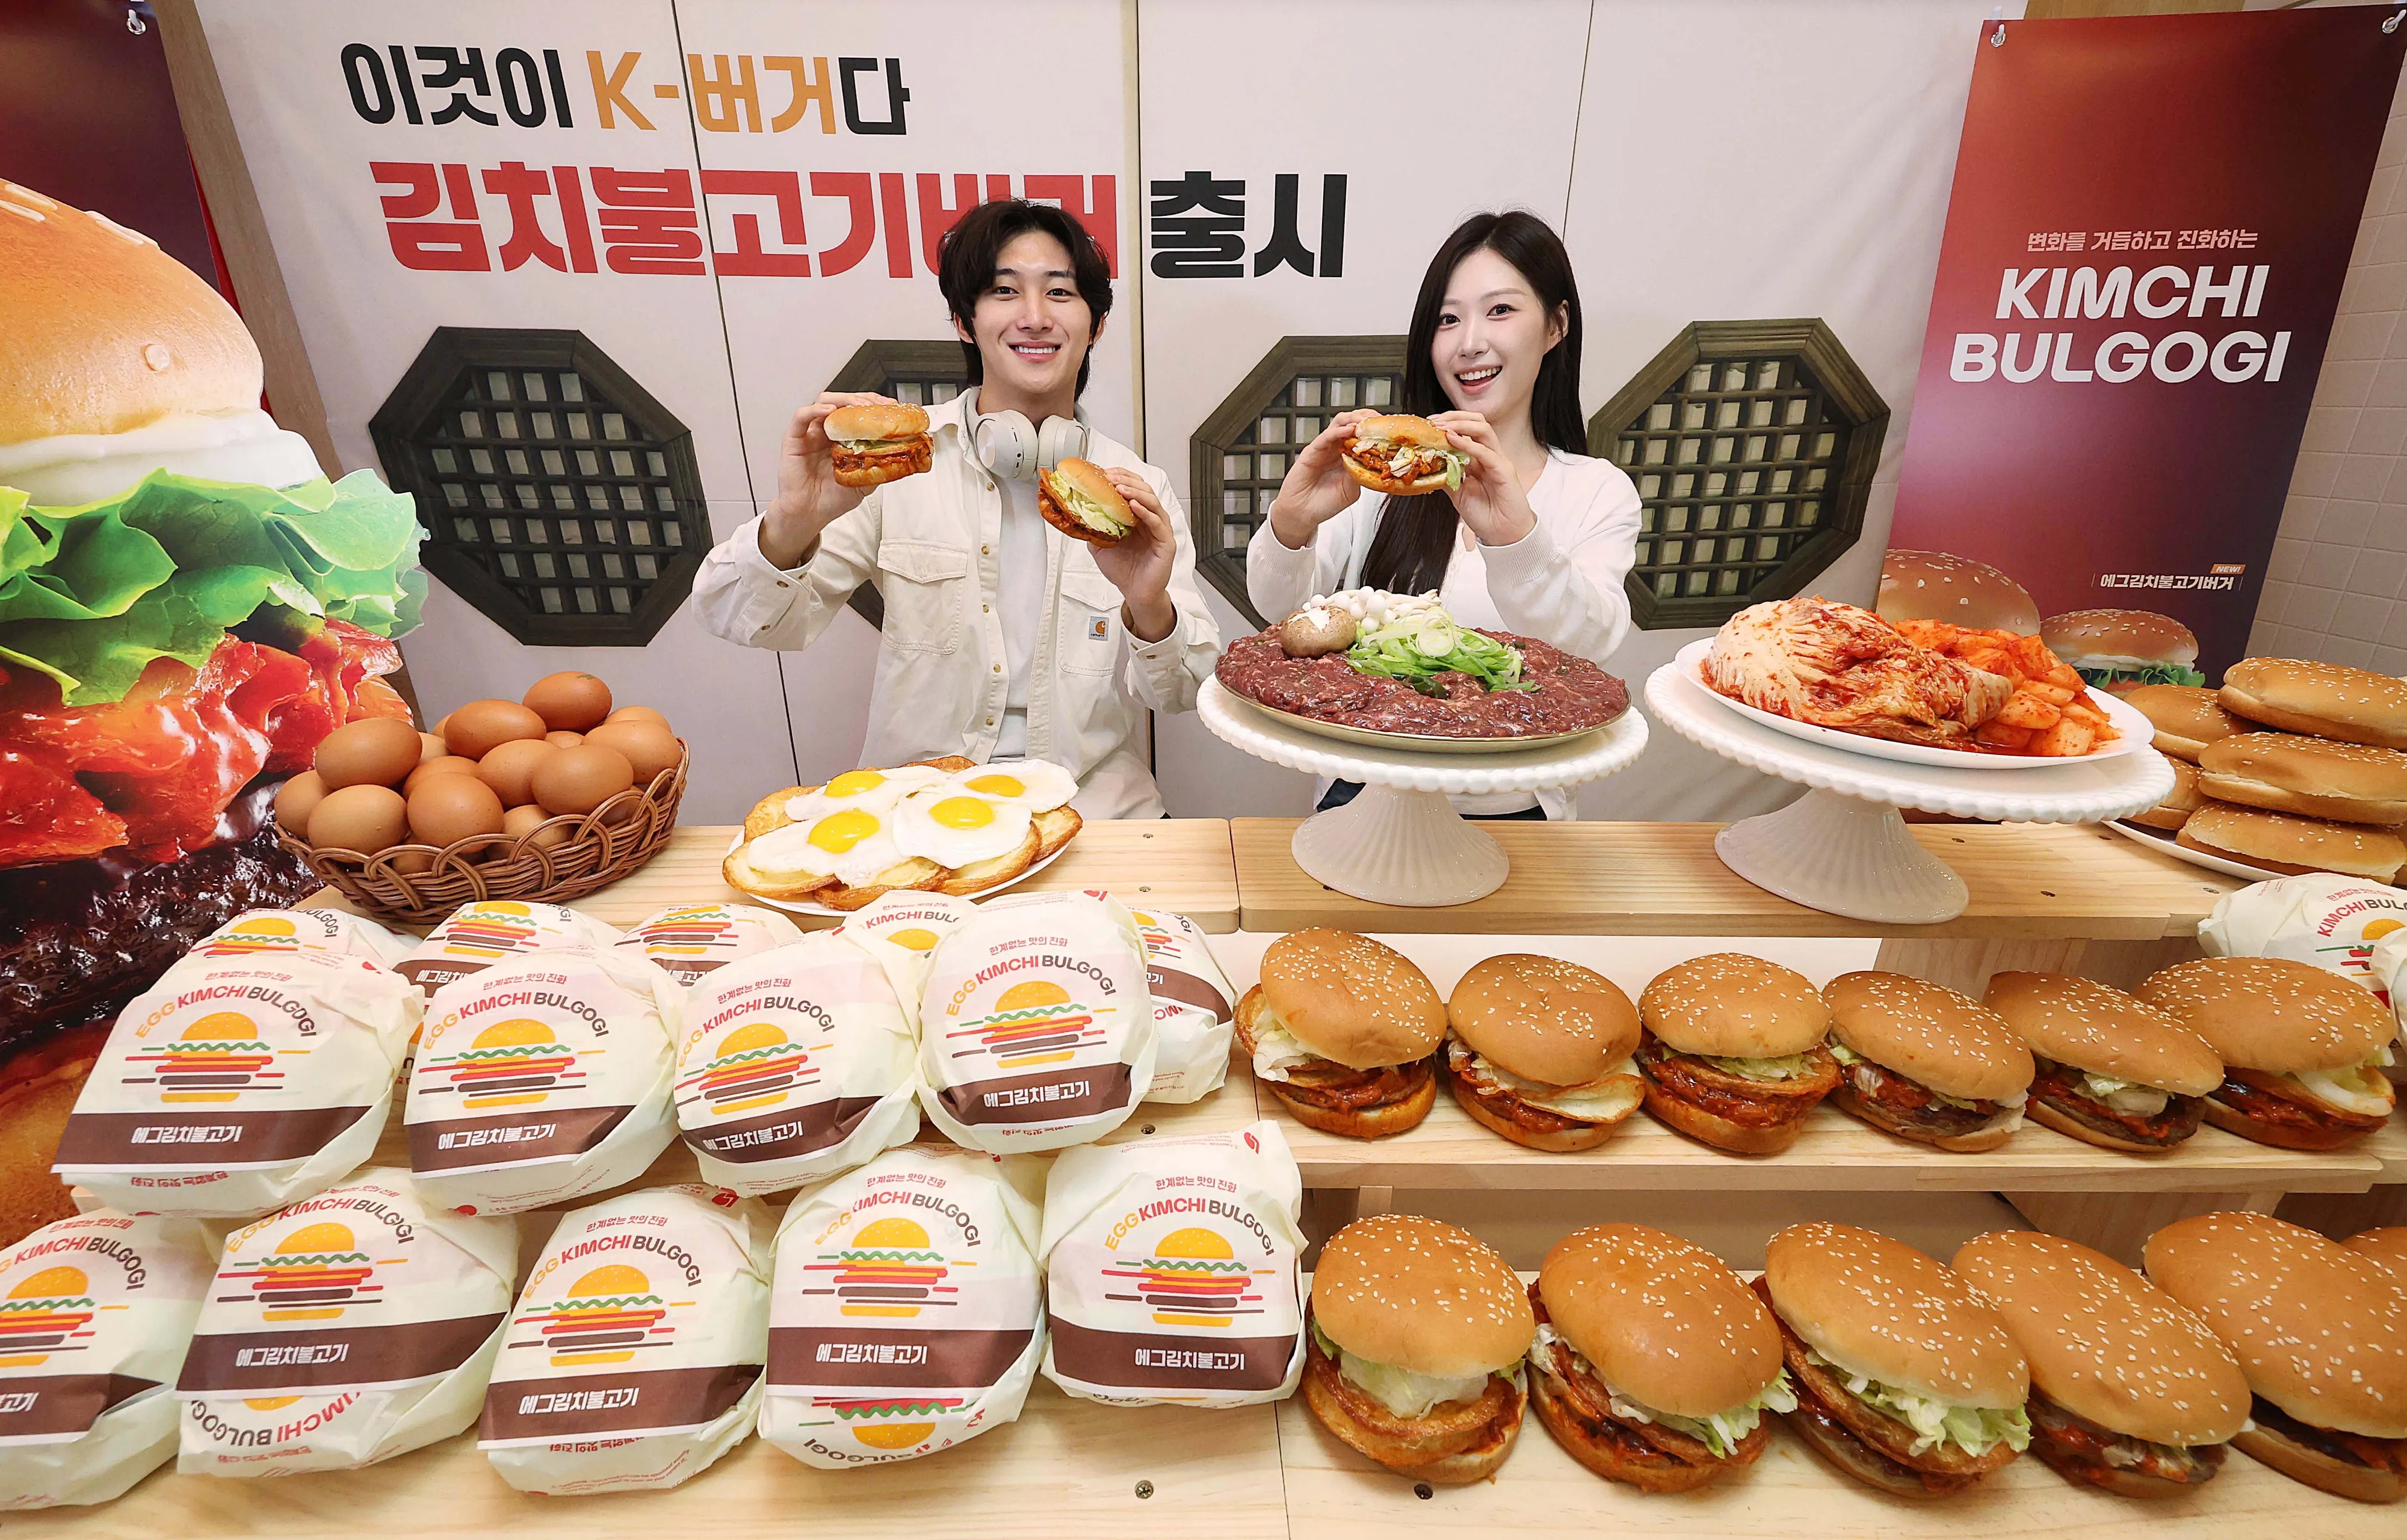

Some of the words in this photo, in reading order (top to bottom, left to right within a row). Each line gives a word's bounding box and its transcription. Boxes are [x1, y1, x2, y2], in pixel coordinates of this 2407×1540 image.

[341, 43, 573, 128] 이것이
[586, 50, 910, 135] K-버거다
[1150, 170, 1348, 279] 출시
[2027, 232, 2086, 252] 변화를
[2090, 230, 2171, 251] 거듭하고
[2176, 229, 2258, 250] 진화하는
[1995, 265, 2270, 319] KIMCHI
[1948, 330, 2291, 383] BULGOGI
[2100, 574, 2234, 591] 에그김치불고기버거
[866, 911, 922, 929] KIMCHI
[2317, 901, 2367, 937] KIMCHI
[989, 939, 1027, 956] 한계없는
[1028, 937, 1047, 946] 맛의
[1049, 937, 1068, 947] 진화
[527, 973, 545, 982] 맛의
[546, 973, 567, 985] 진화
[717, 985, 753, 1004] 한계없는
[755, 979, 771, 989] 맛의
[773, 978, 792, 988] 진화
[946, 979, 976, 1016] EGG
[975, 955, 1039, 985] KIMCHI
[1042, 955, 1116, 996] BULGOGI
[134, 1002, 176, 1038] EGG
[177, 985, 249, 1009] KIMCHI
[247, 987, 317, 1037] BULGOGI
[423, 1012, 459, 1050] EGG
[459, 992, 531, 1019] KIMCHI
[533, 992, 609, 1037] BULGOGI
[703, 999, 761, 1033] KIMCHI
[764, 996, 835, 1032] BULGOGI
[983, 1080, 1090, 1109] 에그김치불고기
[131, 1126, 243, 1144] 에그김치불고기
[437, 1123, 557, 1150] 에그김치불고기
[702, 1121, 803, 1151] 에그김치불고기
[867, 1174, 905, 1187] 한계없는
[907, 1173, 927, 1183] 맛의
[927, 1175, 947, 1188] 진화
[1155, 1176, 1194, 1190] 한계없는
[1196, 1176, 1216, 1188] 맛의
[1217, 1179, 1237, 1194] 진화
[278, 1198, 357, 1221] KIMCHI
[912, 1194, 981, 1247] BULGOGI
[586, 1216, 626, 1233] 한계없는
[629, 1215, 648, 1225] 맛의
[648, 1216, 668, 1227] 진화
[1104, 1212, 1139, 1251] EGG
[1139, 1198, 1206, 1222] KIMCHI
[1208, 1200, 1275, 1255] BULGOGI
[14, 1237, 91, 1264] KIMCHI
[86, 1237, 146, 1290] BULGOGI
[524, 1257, 558, 1299] EGG
[561, 1235, 632, 1264] KIMCHI
[632, 1235, 702, 1287] BULGOGI
[235, 1343, 349, 1367] 에그김치불고기
[815, 1343, 928, 1364] 에그김치불고기
[1134, 1348, 1245, 1371] 에그김치불고기
[518, 1387, 640, 1415] 에그김치불고기
[277, 1391, 360, 1443] IMCHI
